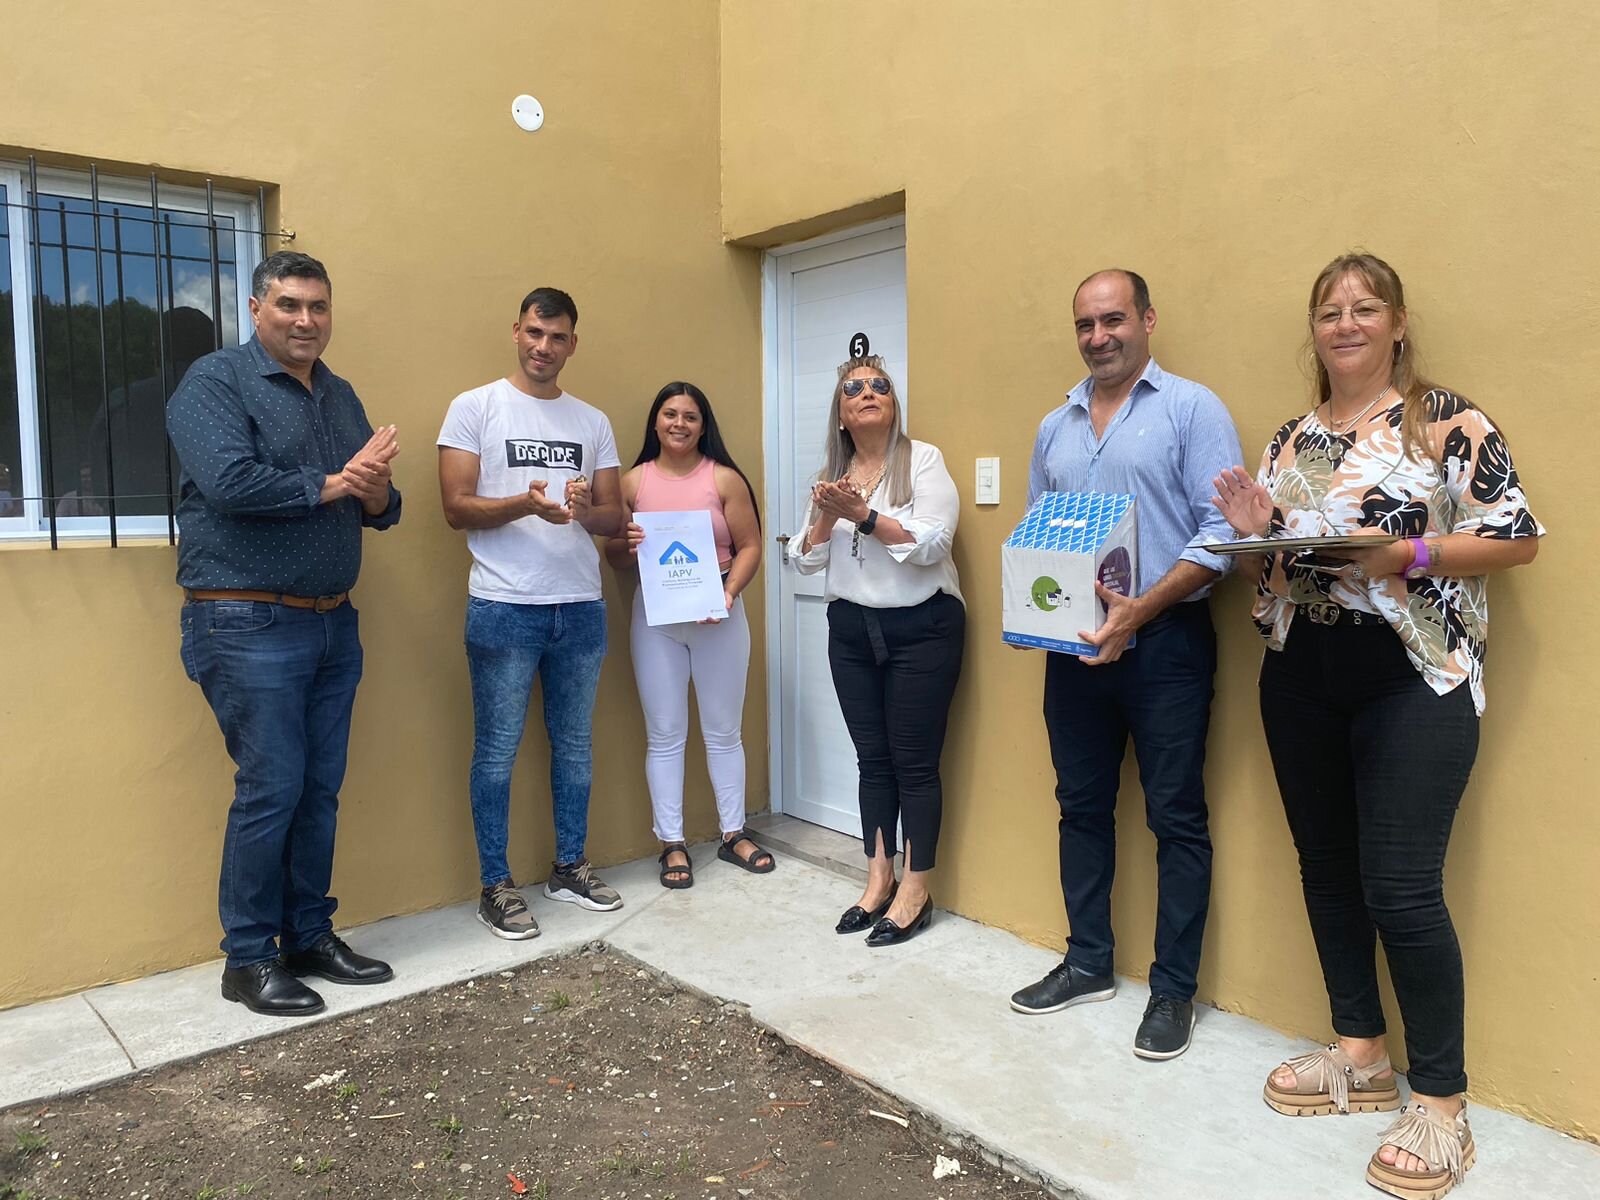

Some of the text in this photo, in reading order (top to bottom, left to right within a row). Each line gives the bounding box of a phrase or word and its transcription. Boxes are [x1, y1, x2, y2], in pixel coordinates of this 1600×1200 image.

[855, 338, 863, 358] 5
[513, 444, 577, 465] DECIDE
[668, 568, 692, 578] IAPV
